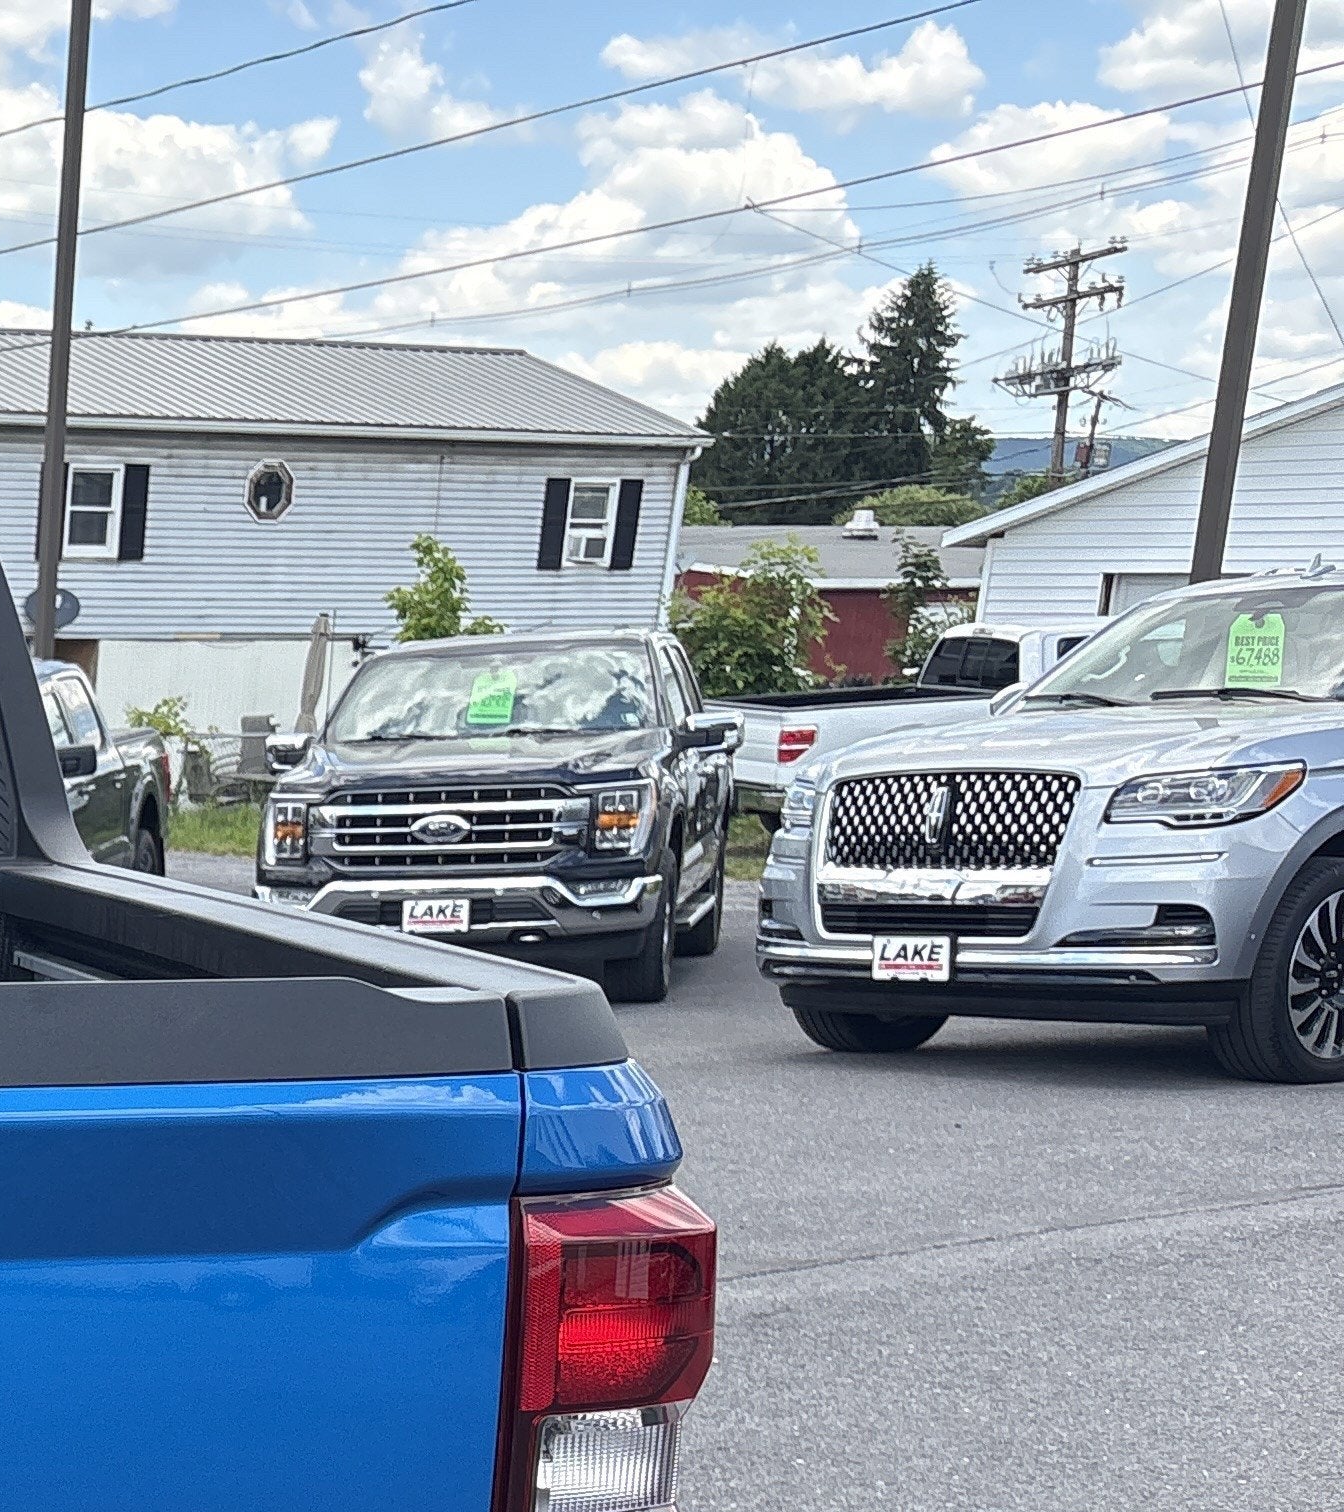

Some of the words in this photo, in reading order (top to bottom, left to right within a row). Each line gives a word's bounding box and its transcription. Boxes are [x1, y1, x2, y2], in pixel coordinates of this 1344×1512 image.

[1234, 635, 1256, 647] BEST
[1257, 635, 1280, 647] PRICE
[408, 902, 464, 919] LAKE
[878, 943, 944, 962] LAKE
